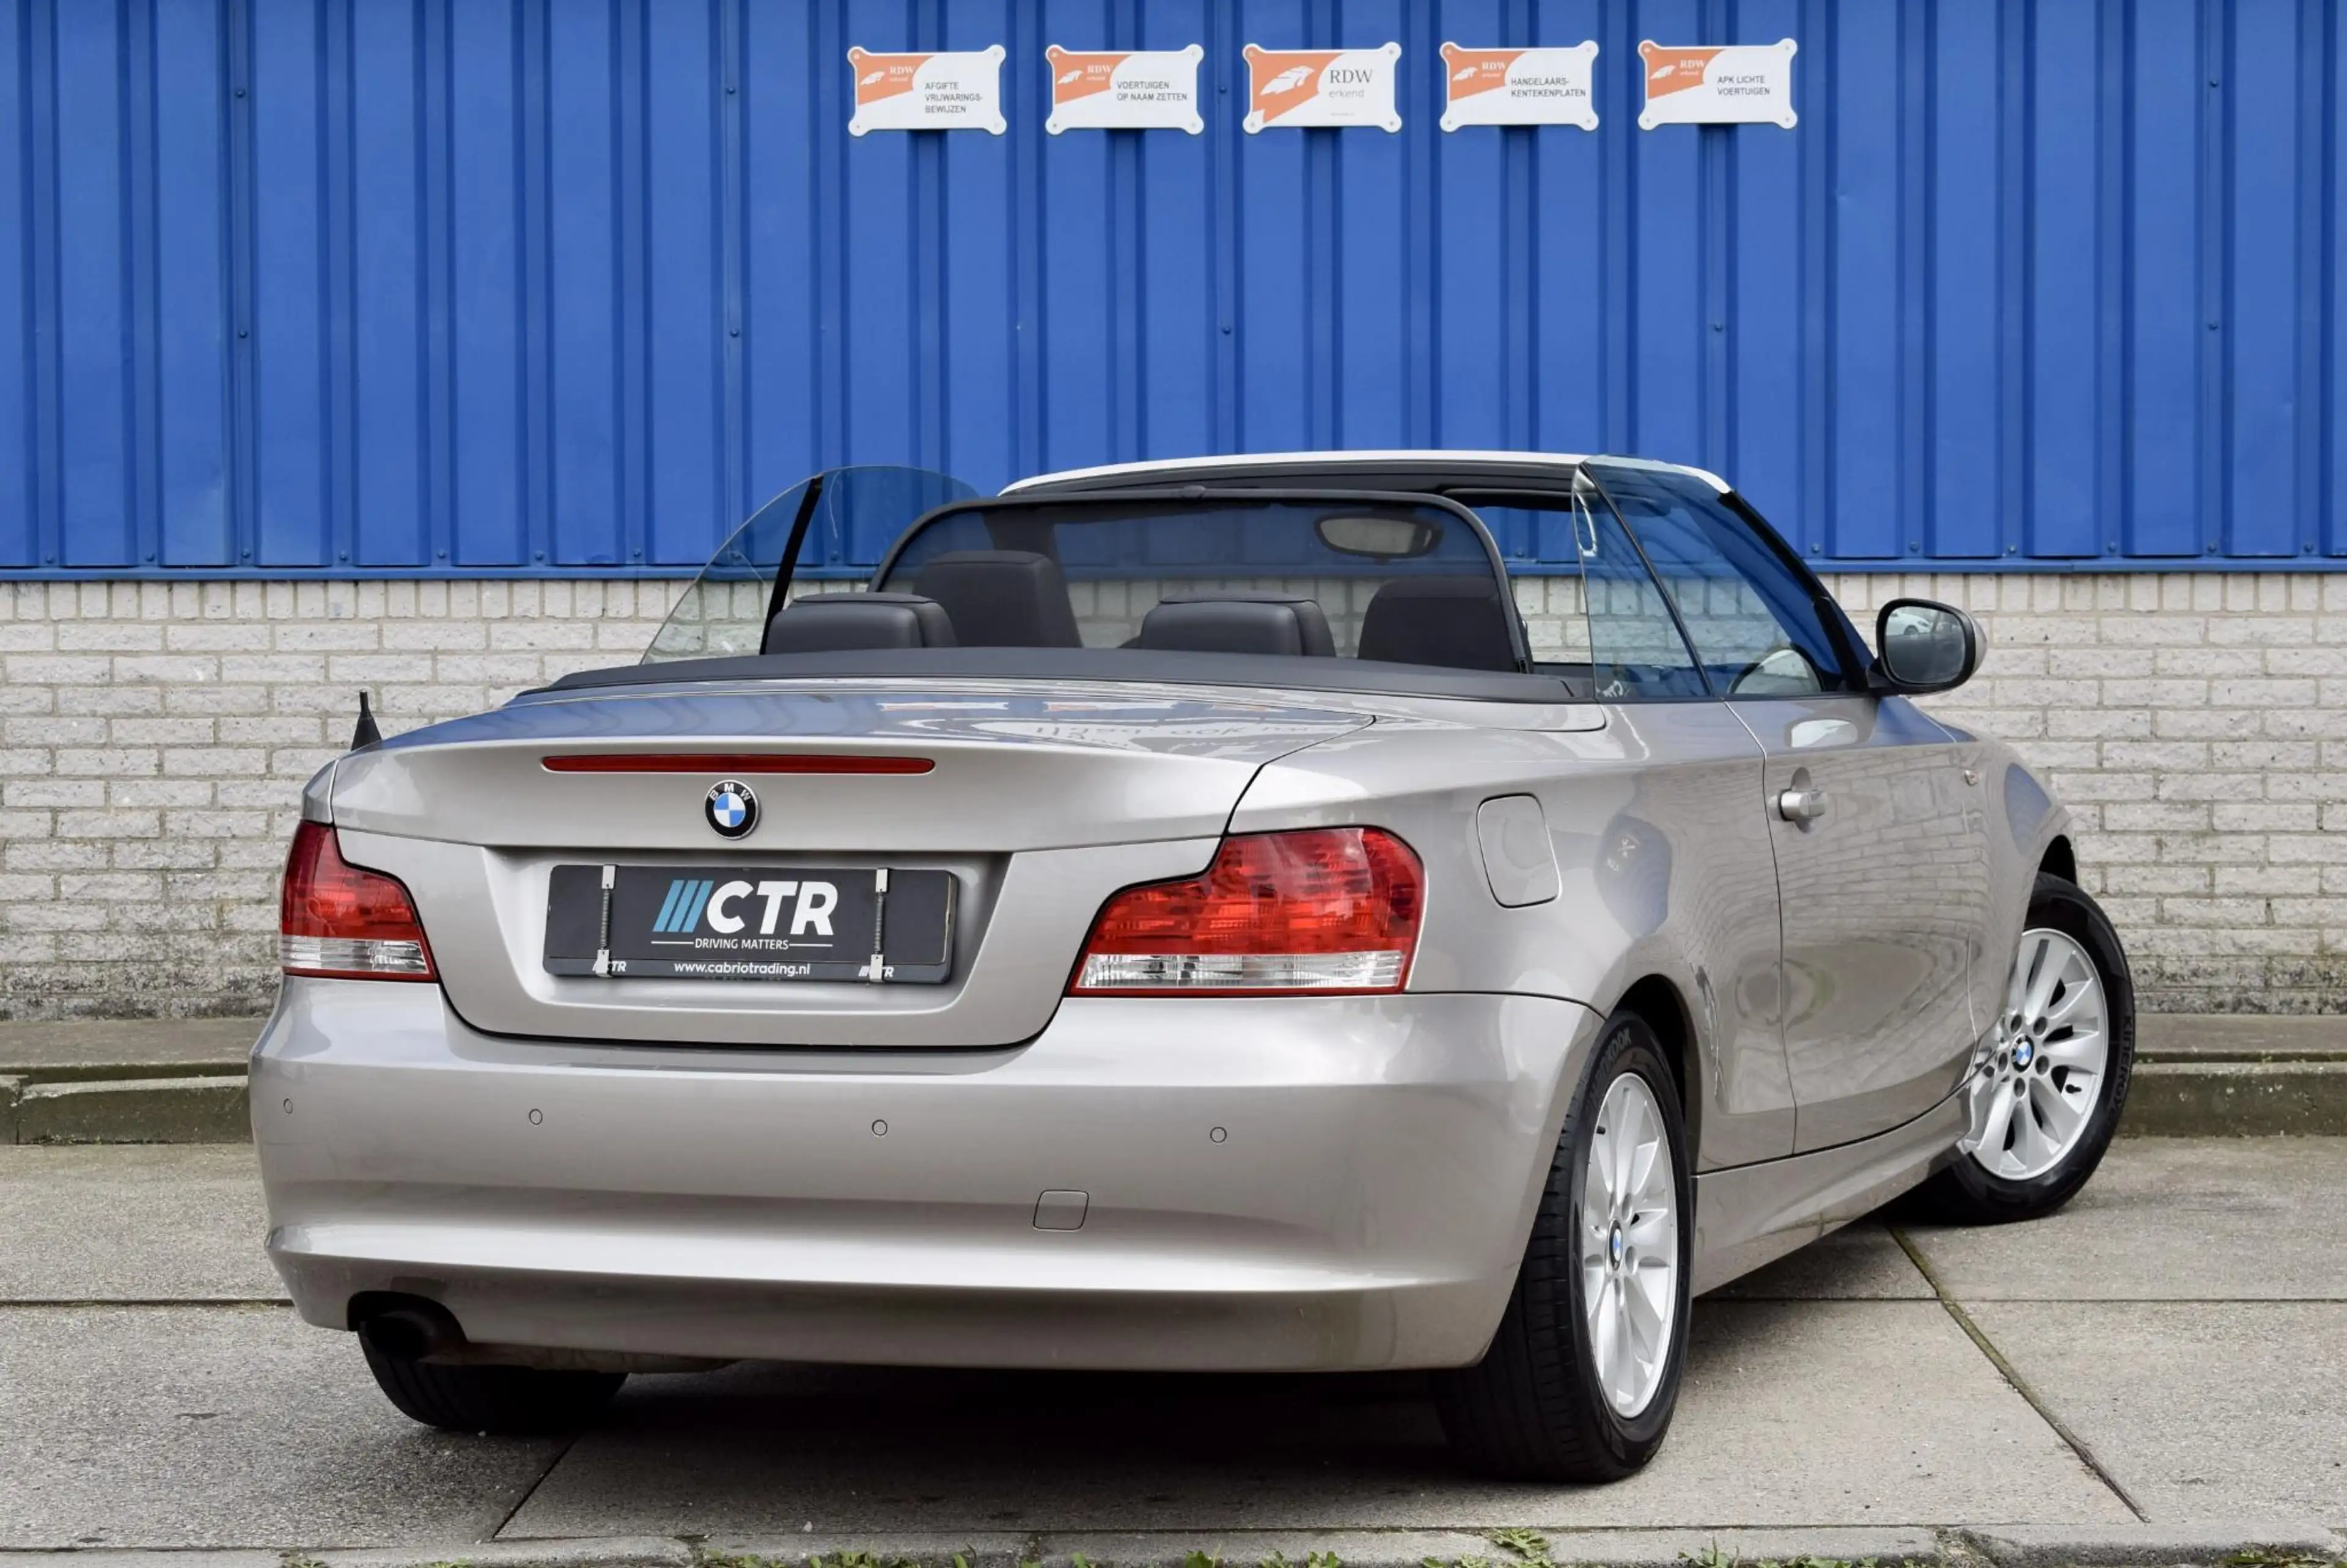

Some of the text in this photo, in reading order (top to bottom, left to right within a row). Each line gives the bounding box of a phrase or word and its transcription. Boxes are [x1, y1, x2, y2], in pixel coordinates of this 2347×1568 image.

[1482, 61, 1507, 70] RDW
[1680, 59, 1705, 69] RDW
[890, 65, 916, 75] RDW
[1087, 64, 1115, 74] RDW
[1329, 68, 1373, 84] RDW
[1717, 75, 1765, 84] APK LICHTE
[925, 81, 959, 90] AFGIFTE
[1117, 81, 1170, 90] VOERTUIGEN
[1511, 77, 1570, 86] HANDELAARS-
[1511, 89, 1586, 98] KENTEKENPLATEN
[1717, 87, 1770, 95] VOERTUIGEN
[925, 93, 983, 102] VRIJWARINGS-
[1117, 92, 1188, 101] OP NAAM ZETTEN
[925, 104, 967, 114] BEWIJZEN
[709, 783, 752, 801] BMW
[707, 880, 838, 936] CTR
[694, 938, 789, 950] DRIVING MATTERS
[674, 961, 811, 976] www.cabriotrading.nl
